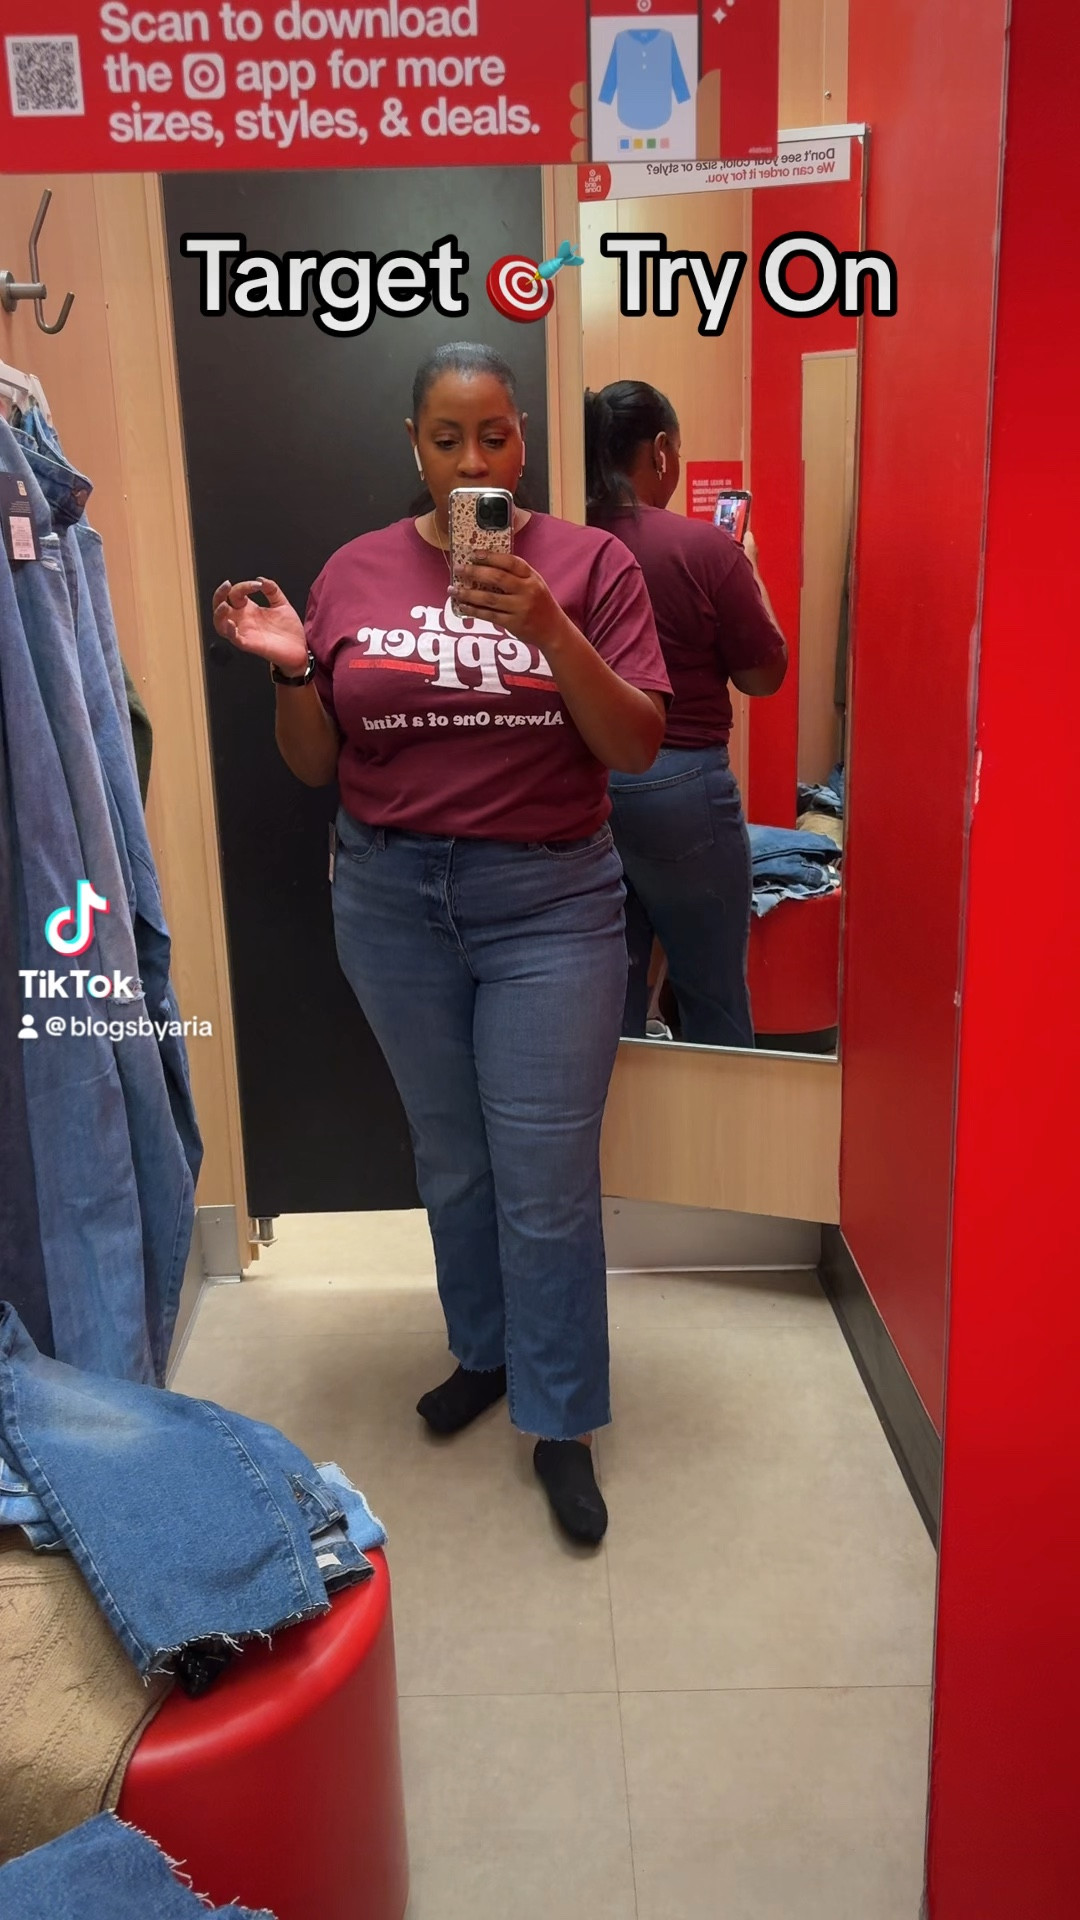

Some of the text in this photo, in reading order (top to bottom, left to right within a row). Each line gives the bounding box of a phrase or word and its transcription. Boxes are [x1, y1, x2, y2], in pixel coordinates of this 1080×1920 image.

[100, 0, 478, 43] Scan to download
[104, 49, 506, 99] the app for more
[109, 96, 540, 148] sizes, styles, & deals.
